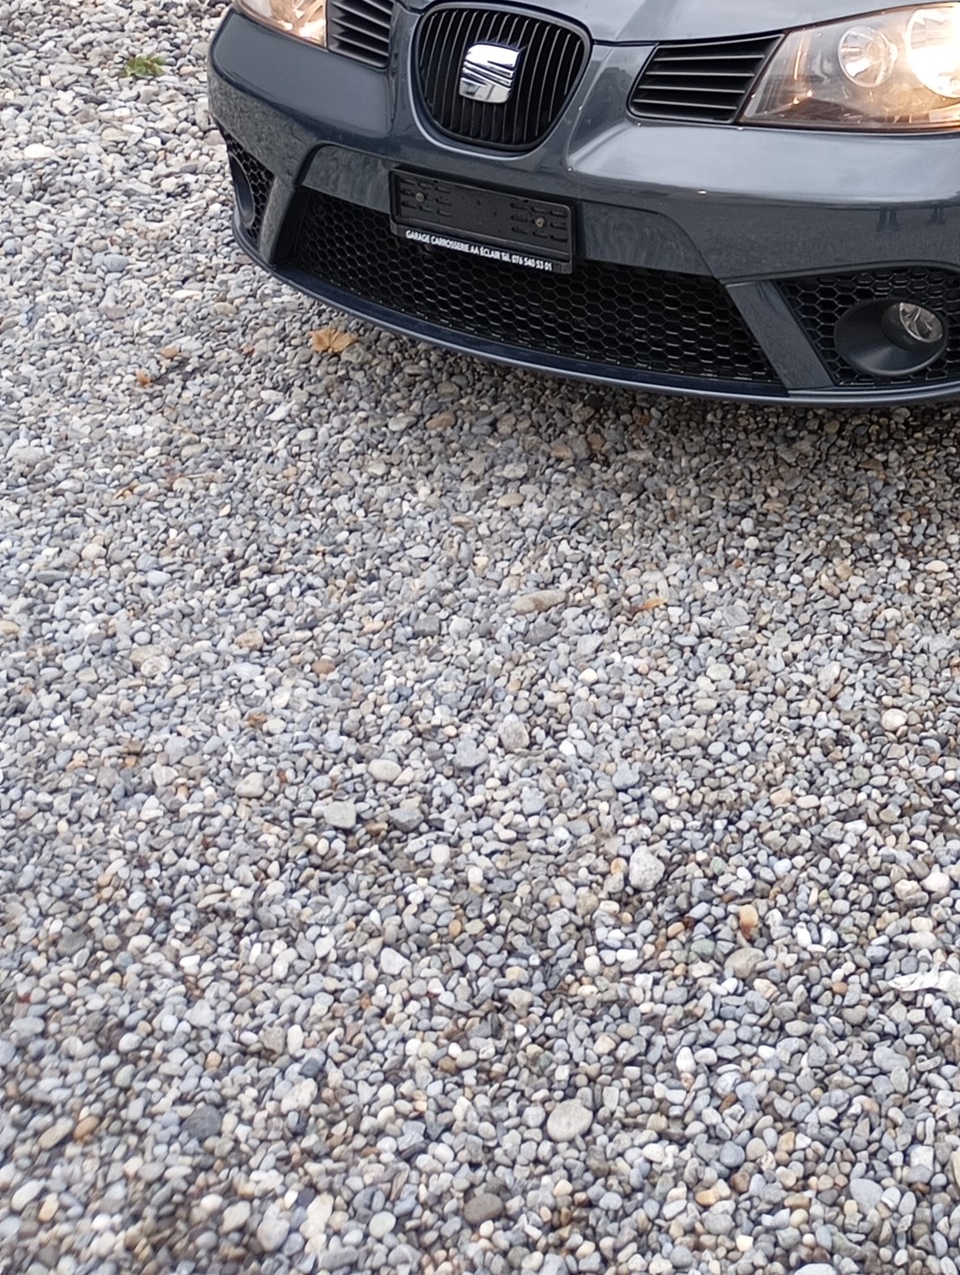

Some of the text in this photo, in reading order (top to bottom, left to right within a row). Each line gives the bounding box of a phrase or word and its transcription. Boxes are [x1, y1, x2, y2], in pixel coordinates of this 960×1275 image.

[405, 230, 431, 243] GARAGE
[431, 236, 470, 253] CARROSSERIE
[480, 246, 500, 260] ÉCLAIR
[511, 255, 523, 265] 076
[524, 257, 535, 268] 540
[535, 260, 544, 269] 53
[544, 262, 552, 271] 01
